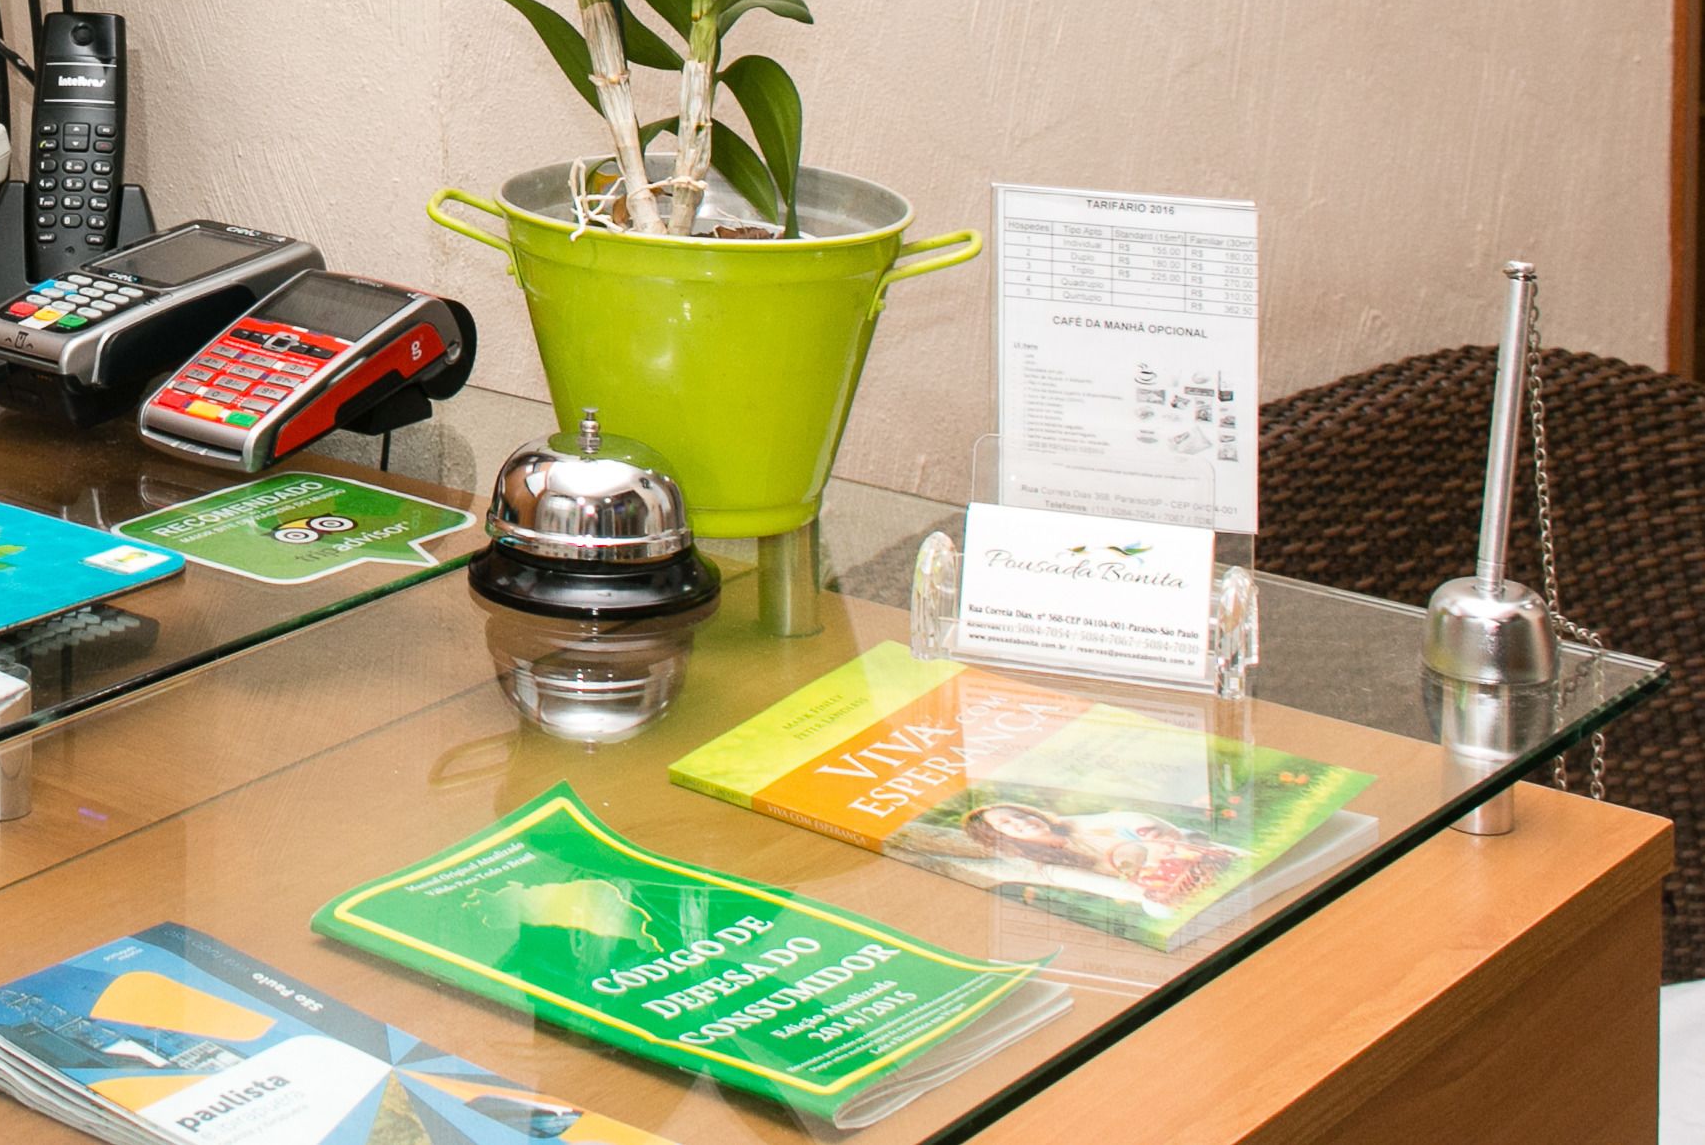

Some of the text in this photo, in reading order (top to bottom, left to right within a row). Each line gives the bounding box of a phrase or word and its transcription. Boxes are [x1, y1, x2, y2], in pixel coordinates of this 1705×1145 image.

[1087, 199, 1175, 215] TARIFÁRIO 2016
[1063, 239, 1102, 250] Individual
[1053, 315, 1208, 339] CAFÉ DA MANHÃ OPCIONAL
[151, 481, 324, 539] RECOMENDADO
[1021, 484, 1039, 493] Rua
[1171, 500, 1190, 509] CEP
[984, 549, 1188, 590] Pousada Bonita
[969, 604, 983, 613] Rua
[1176, 629, 1199, 639] Paulo
[814, 694, 1008, 779] VIVA COM
[847, 702, 1063, 819] ESPERANÇA
[767, 805, 867, 844] VIVA COM ESPERANÇA
[591, 915, 774, 995] CÓDIGO DE
[641, 936, 821, 1020] DEFESA DO
[251, 972, 324, 1012] São Paulo
[678, 943, 901, 1045] CONSUMIDOR
[770, 978, 898, 1040] Edição Atualizada
[807, 989, 918, 1043] 2014/2015
[175, 1074, 292, 1133] paulista
